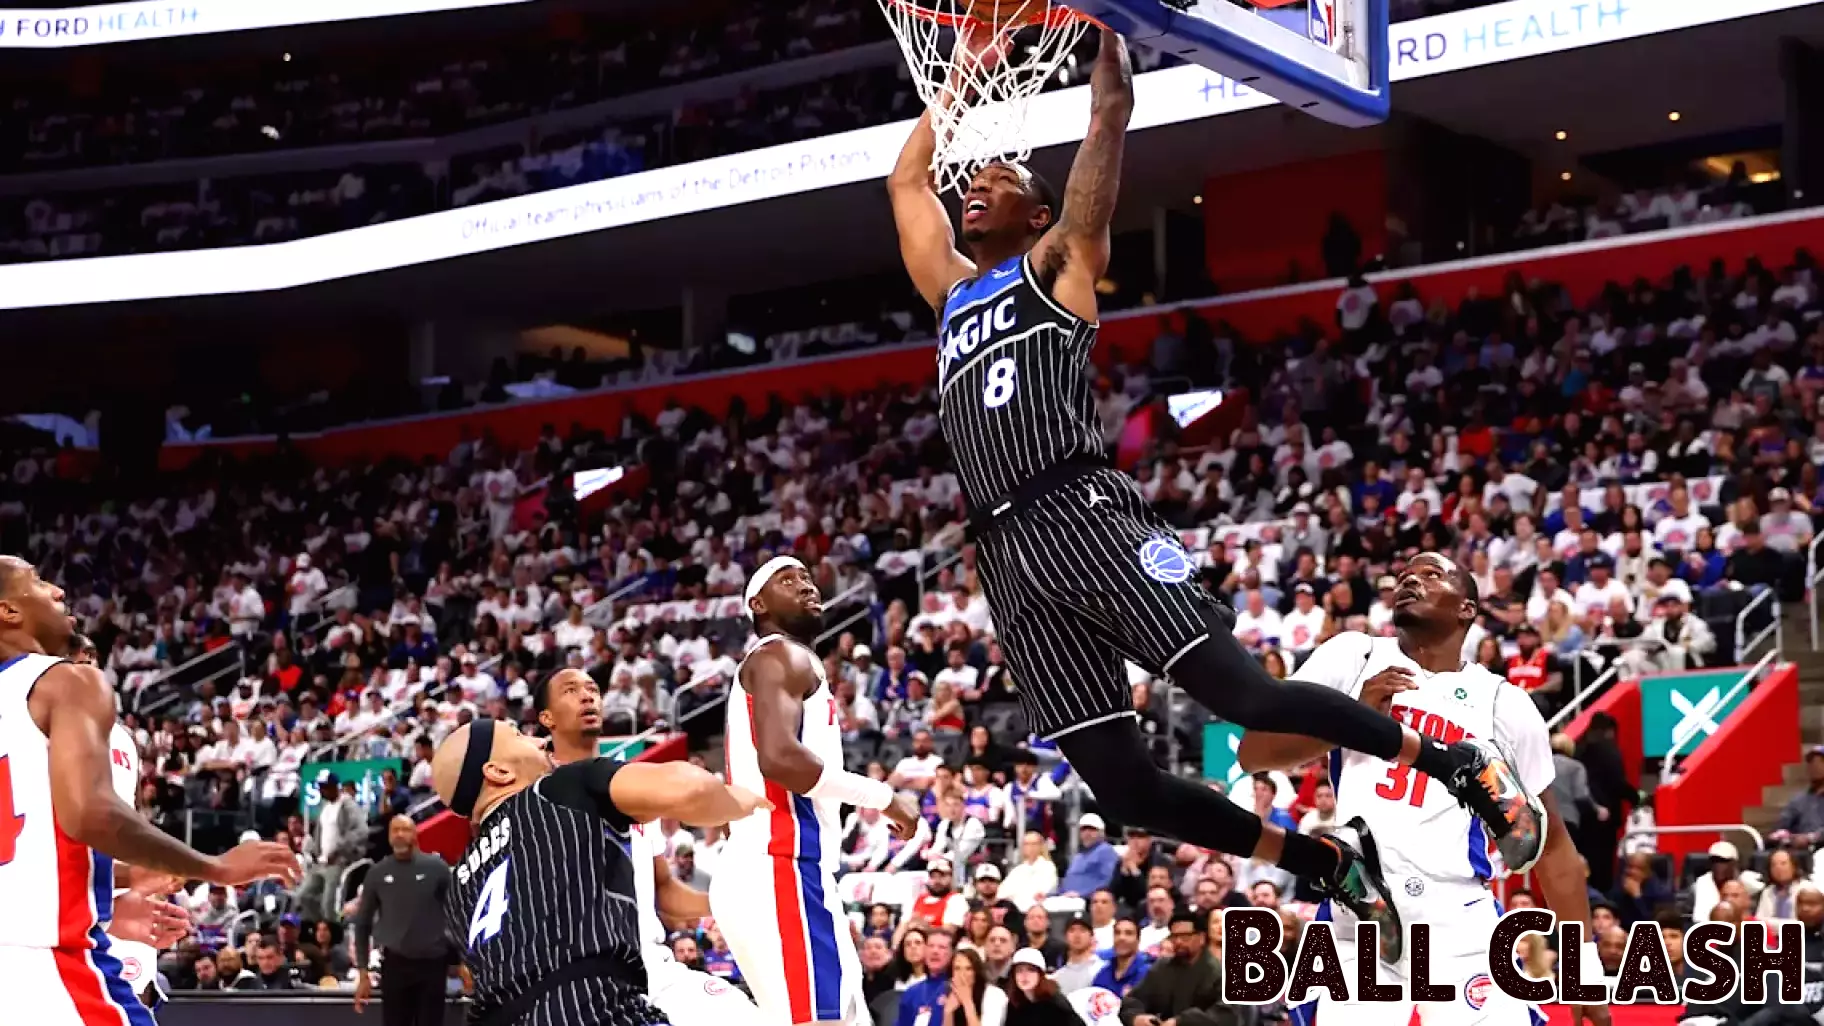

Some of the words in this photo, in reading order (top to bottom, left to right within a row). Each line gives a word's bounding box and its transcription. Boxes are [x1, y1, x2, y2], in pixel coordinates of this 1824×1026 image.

[16, 17, 89, 38] FORD
[98, 7, 199, 32] HEALTH
[1463, 0, 1629, 53] HEALTH
[984, 357, 1017, 409] 8
[1375, 762, 1430, 808] 31
[466, 855, 511, 954] 4
